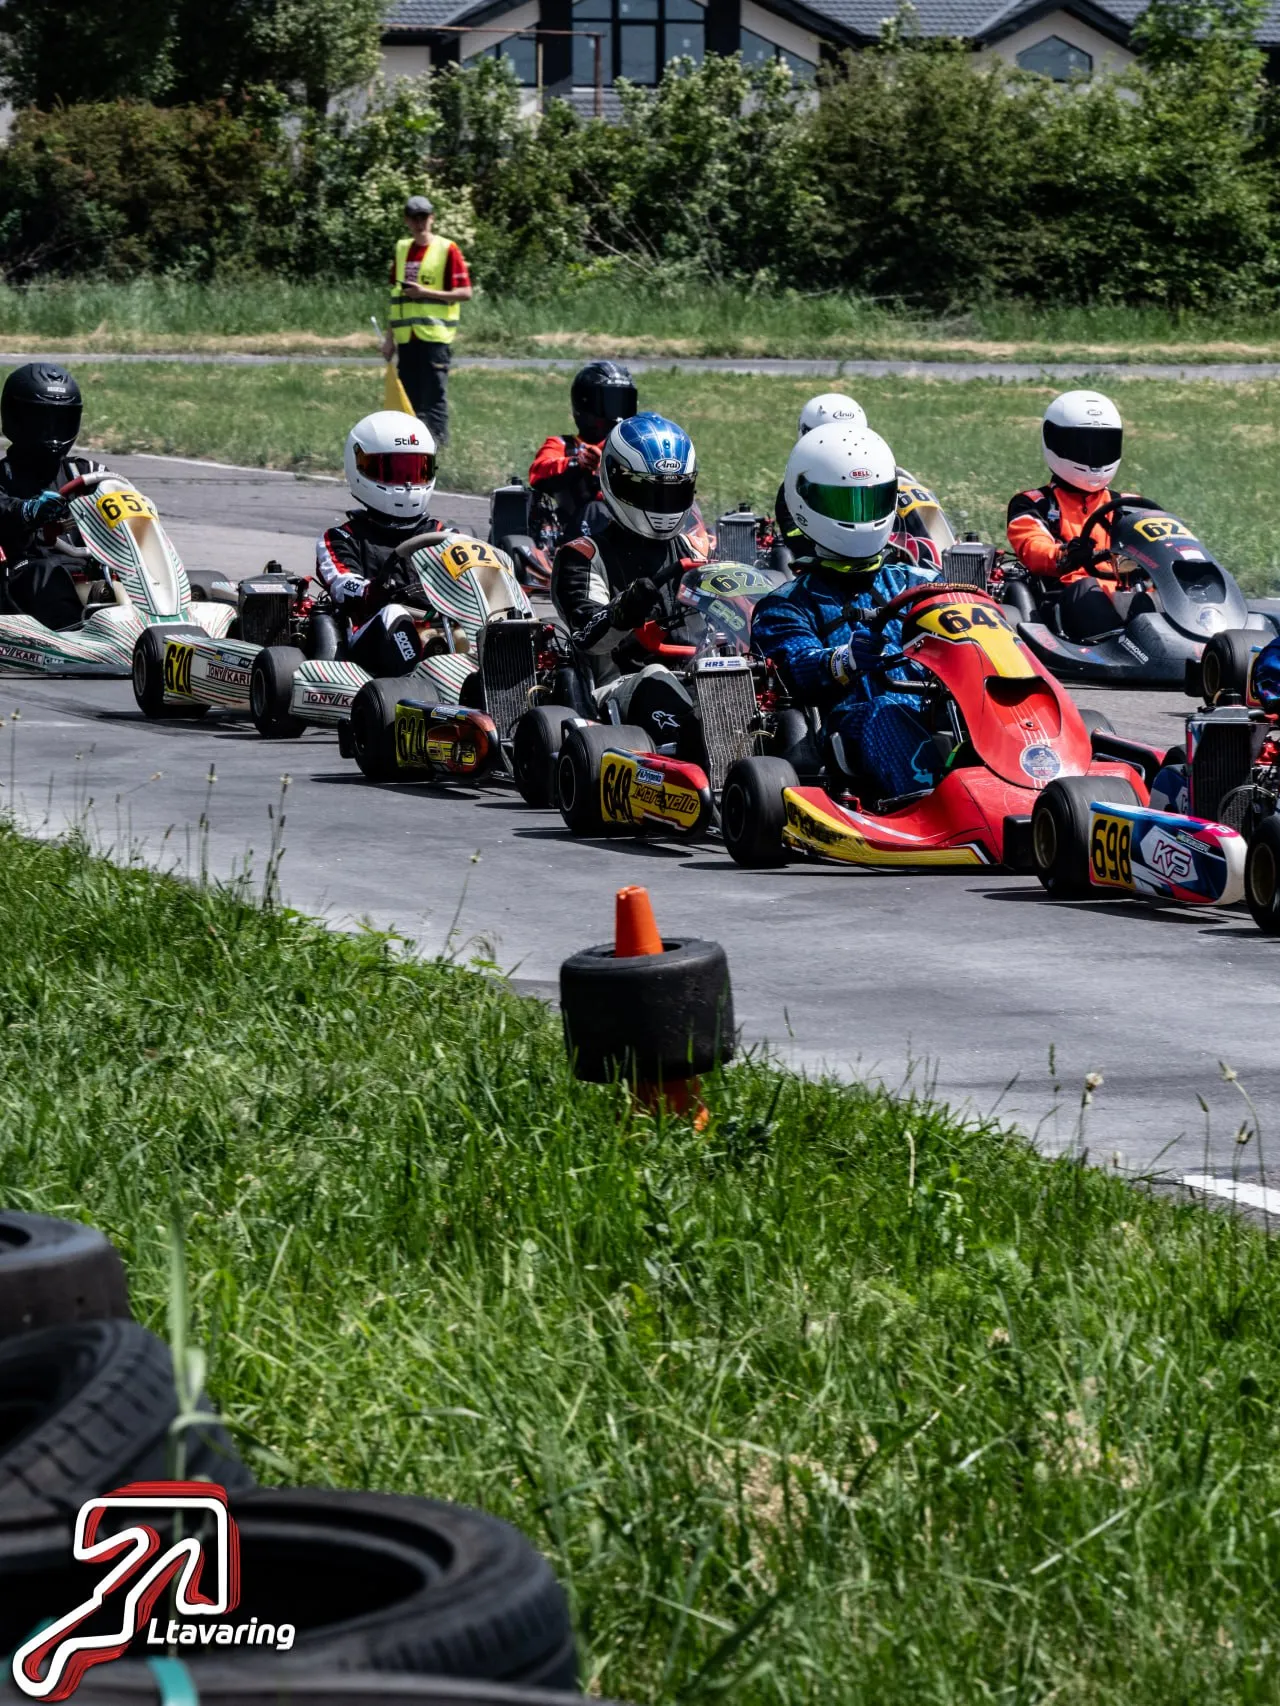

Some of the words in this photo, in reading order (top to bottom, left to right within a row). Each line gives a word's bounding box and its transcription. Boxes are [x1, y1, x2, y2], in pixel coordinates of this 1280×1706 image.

[395, 434, 420, 446] Stilo
[658, 460, 680, 469] Arai
[165, 643, 194, 695] 620
[704, 660, 725, 668] HRS
[603, 763, 633, 823] 648
[1092, 818, 1133, 884] 698
[1153, 839, 1192, 878] KS
